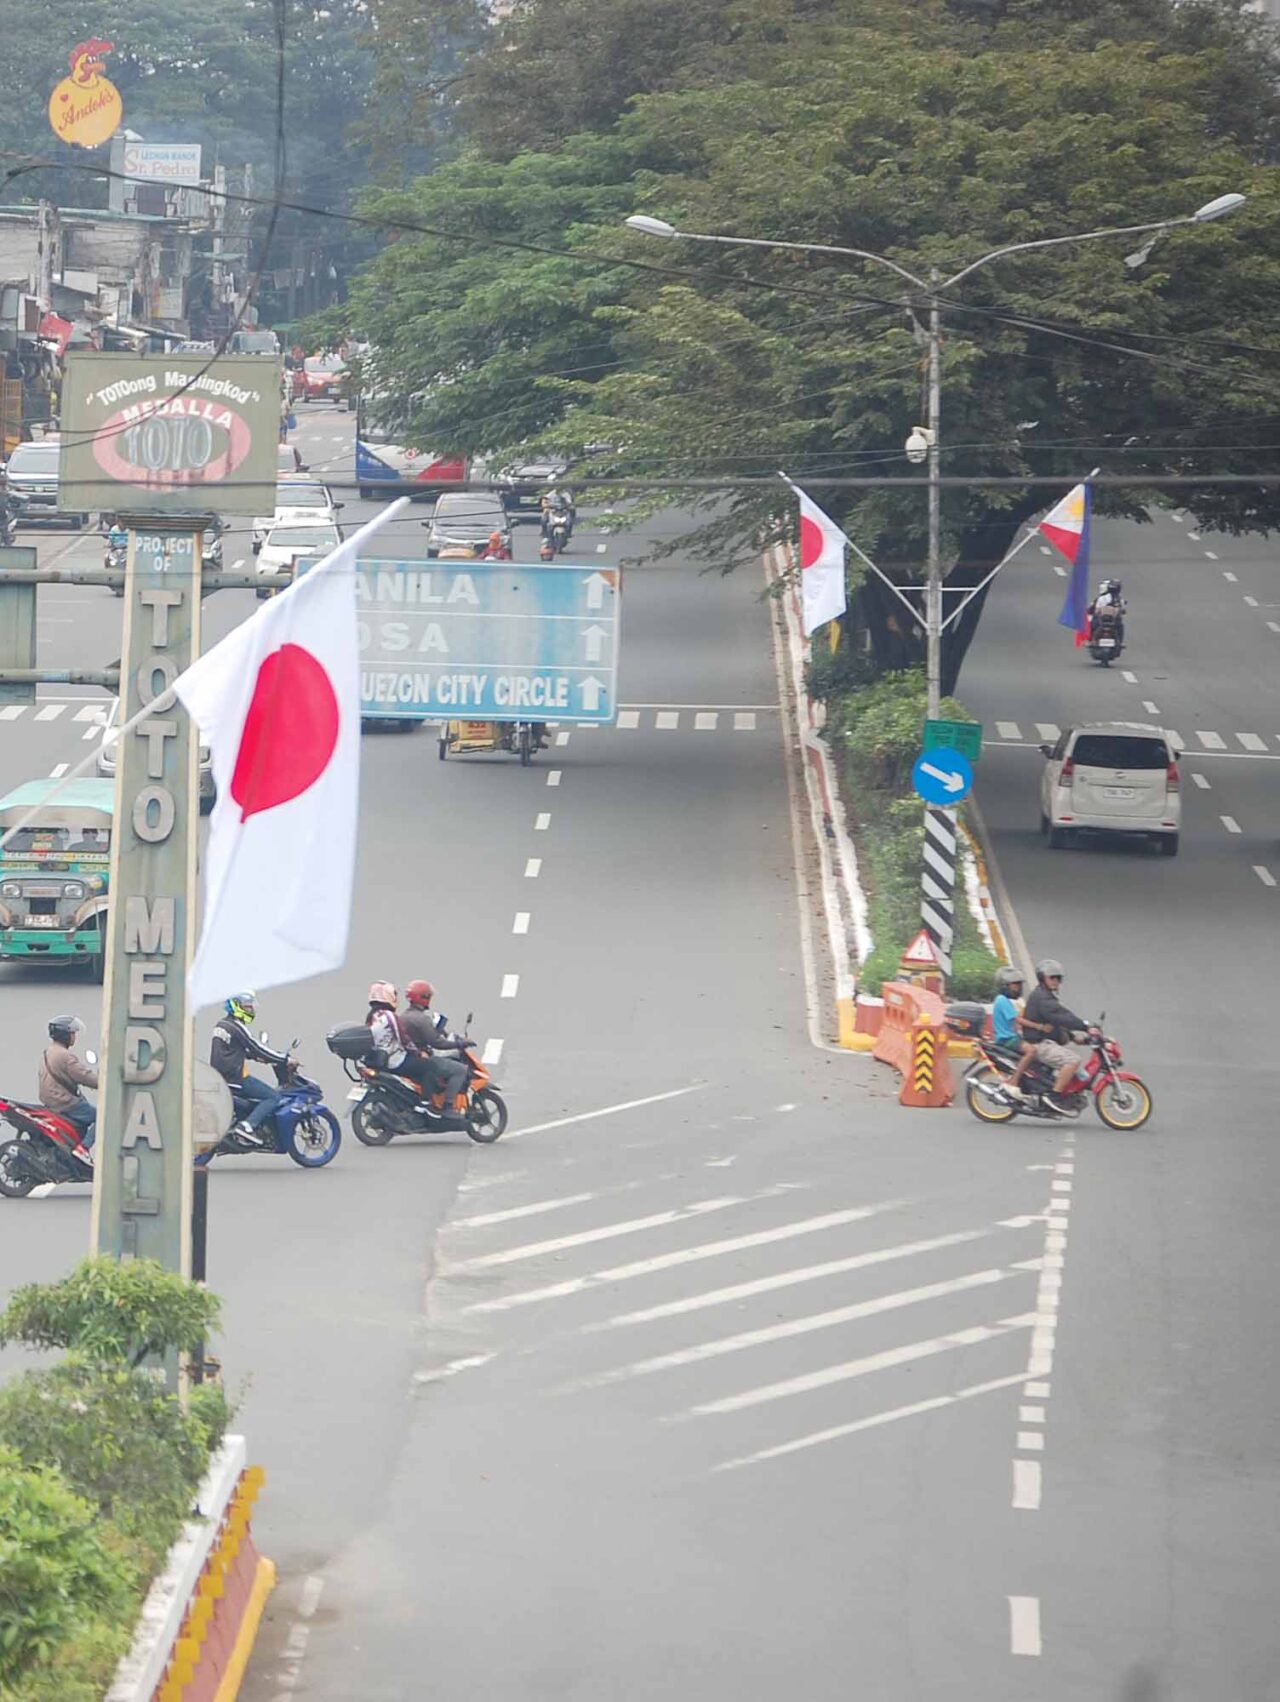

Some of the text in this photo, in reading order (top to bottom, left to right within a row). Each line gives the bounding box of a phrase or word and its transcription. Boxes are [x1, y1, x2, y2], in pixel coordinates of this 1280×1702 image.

[59, 87, 114, 131] Andok's
[152, 161, 196, 176] Pedro
[122, 399, 234, 428] MEDALLA
[124, 416, 213, 470] TOTO
[135, 536, 193, 554] PROJECT
[154, 556, 171, 572] OF
[355, 571, 480, 605] ANILA
[358, 620, 449, 652] DSA
[361, 670, 569, 708] UEZON CITY CIRCLE
[131, 588, 185, 843] TOTO
